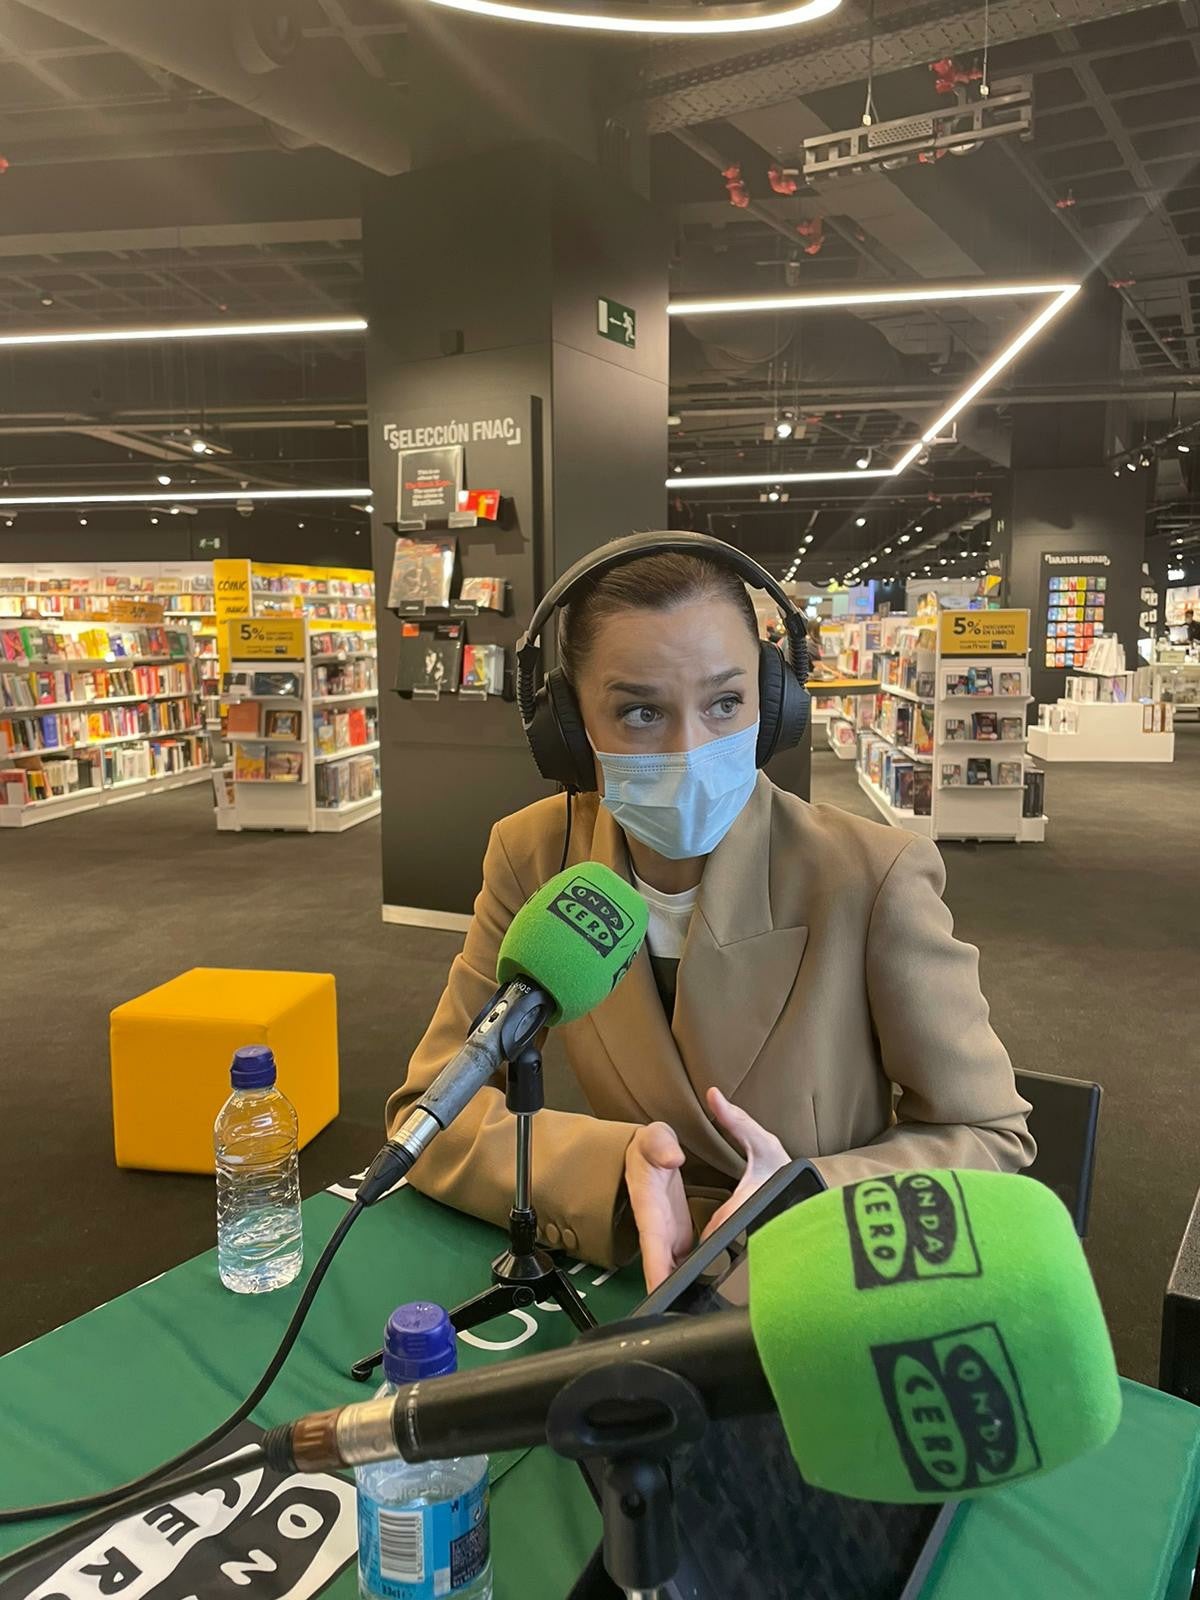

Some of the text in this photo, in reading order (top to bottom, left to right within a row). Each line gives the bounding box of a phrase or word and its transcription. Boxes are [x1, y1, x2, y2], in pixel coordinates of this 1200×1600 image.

[389, 417, 514, 450] SELECCIÓN FNAC
[240, 624, 265, 640] 5%
[953, 617, 981, 635] 5%
[565, 903, 609, 941] CERO
[577, 888, 619, 927] ONDA
[862, 1186, 897, 1261] CERO
[909, 1177, 945, 1253] ONDA
[904, 1376, 957, 1476] CERO
[957, 1359, 1006, 1468] ONDA
